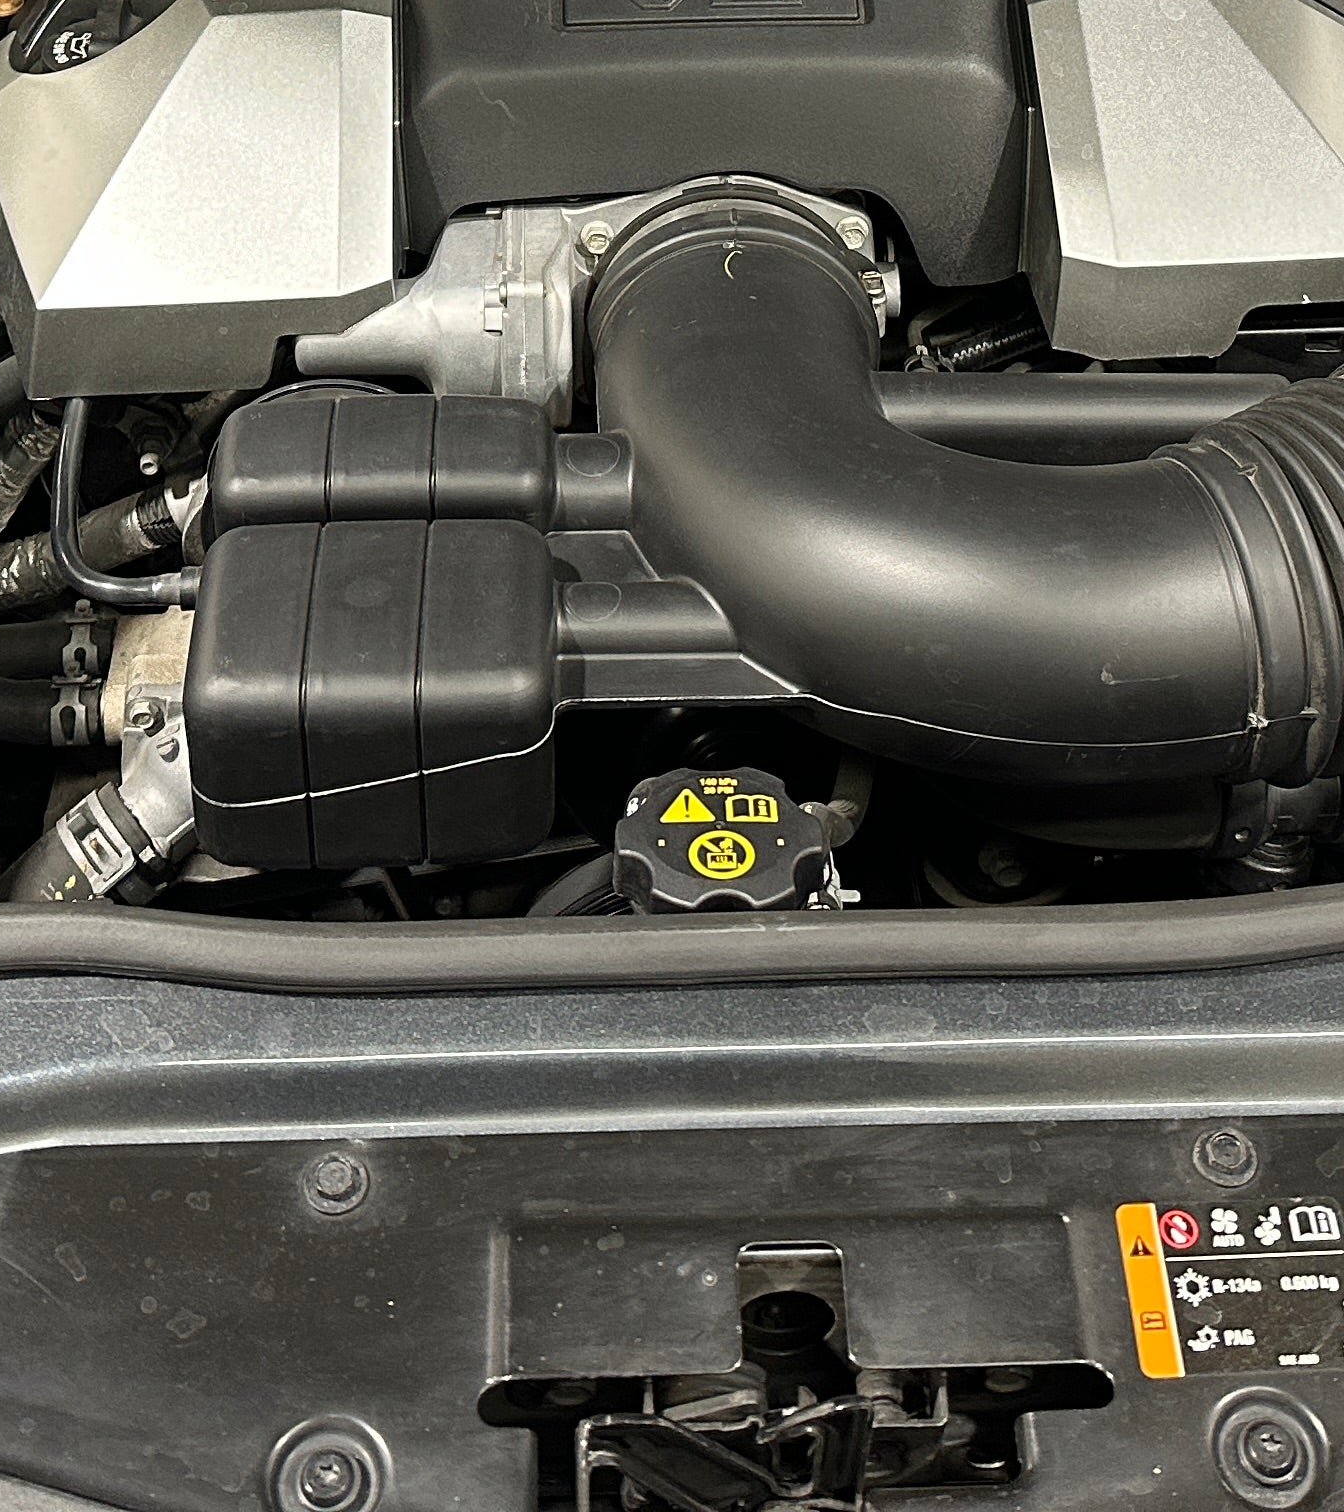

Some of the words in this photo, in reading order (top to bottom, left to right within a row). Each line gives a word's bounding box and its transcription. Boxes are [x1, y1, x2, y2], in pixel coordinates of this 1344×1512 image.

[1212, 1234, 1245, 1248] AUTO
[1212, 1277, 1262, 1294] R-134a
[1319, 1274, 1340, 1292] kg
[1223, 1328, 1256, 1347] PAG
